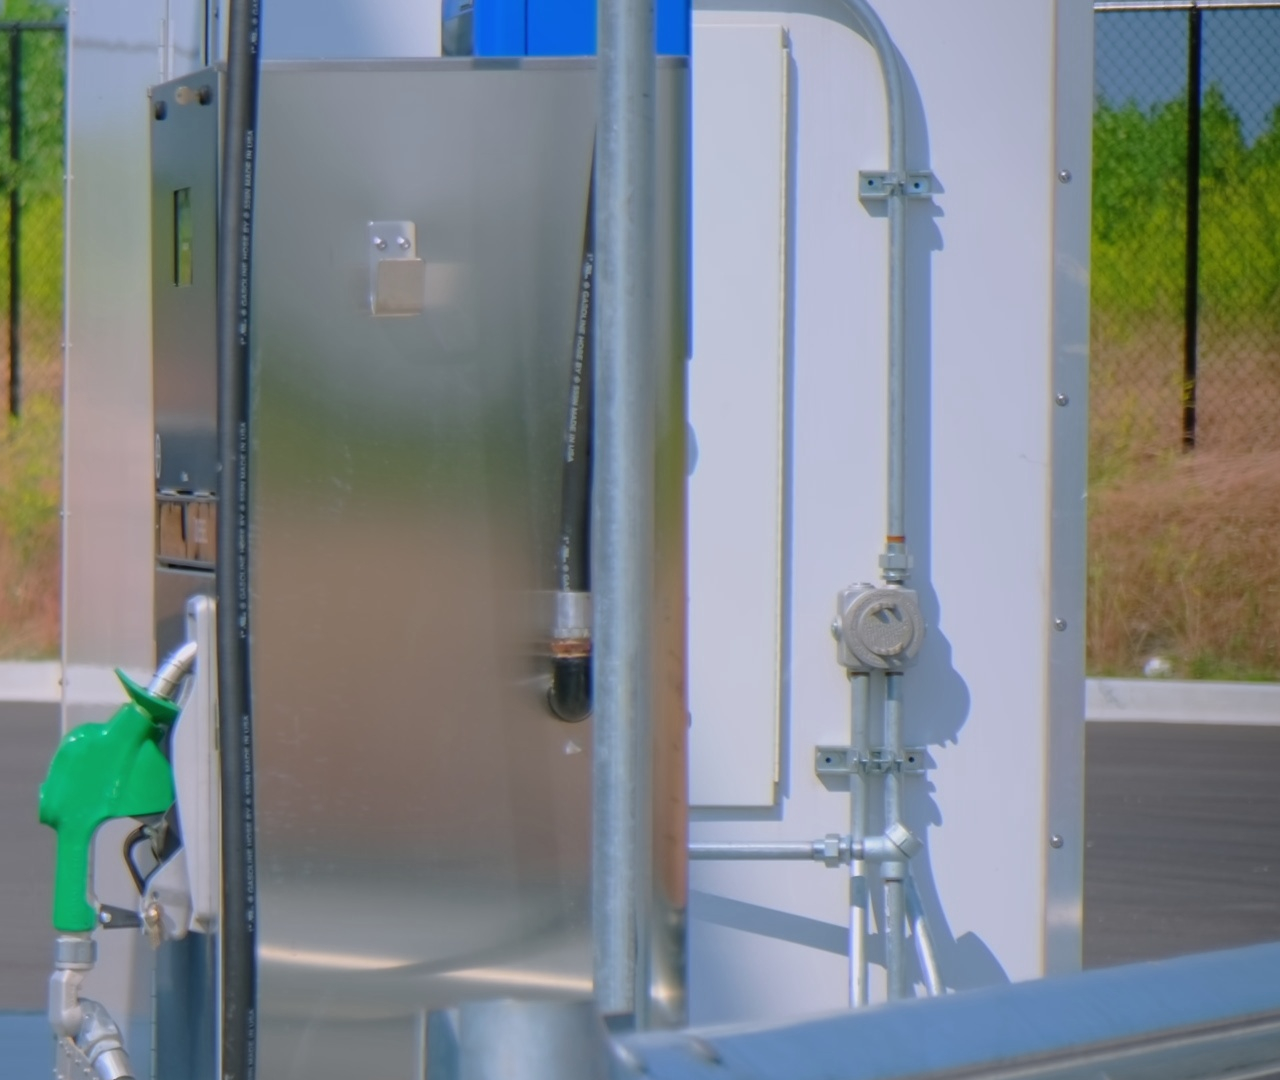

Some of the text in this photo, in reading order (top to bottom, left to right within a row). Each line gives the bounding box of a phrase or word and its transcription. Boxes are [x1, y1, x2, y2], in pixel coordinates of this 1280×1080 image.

[241, 235, 249, 260] HOSE
[240, 262, 248, 307] GASOLINE
[578, 291, 590, 334] GASOLINE
[576, 336, 585, 360] HOSE
[569, 407, 578, 432] MADE
[567, 444, 575, 462] USA
